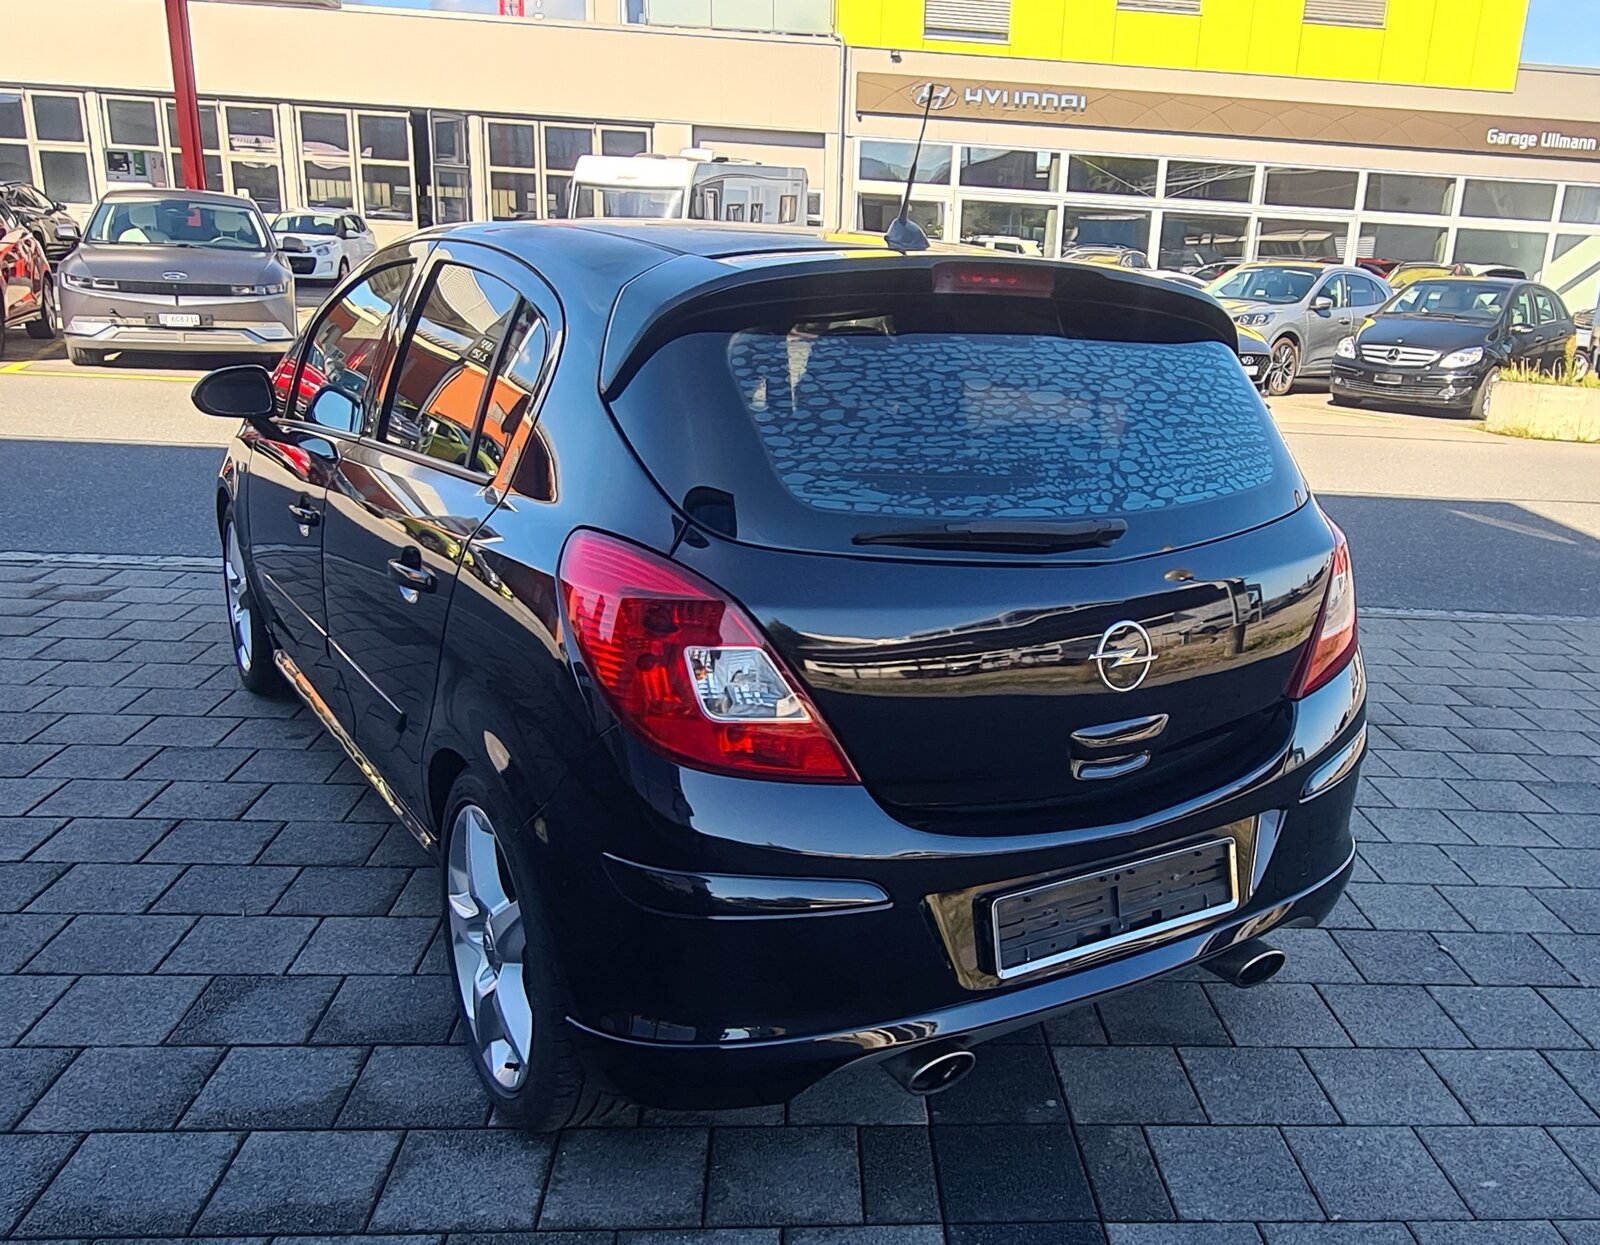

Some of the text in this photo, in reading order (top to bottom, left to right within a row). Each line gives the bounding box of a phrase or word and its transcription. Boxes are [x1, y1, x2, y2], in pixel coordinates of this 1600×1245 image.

[963, 86, 1088, 114] HYUNDAI
[1486, 128, 1597, 151] Garage Ullmann
